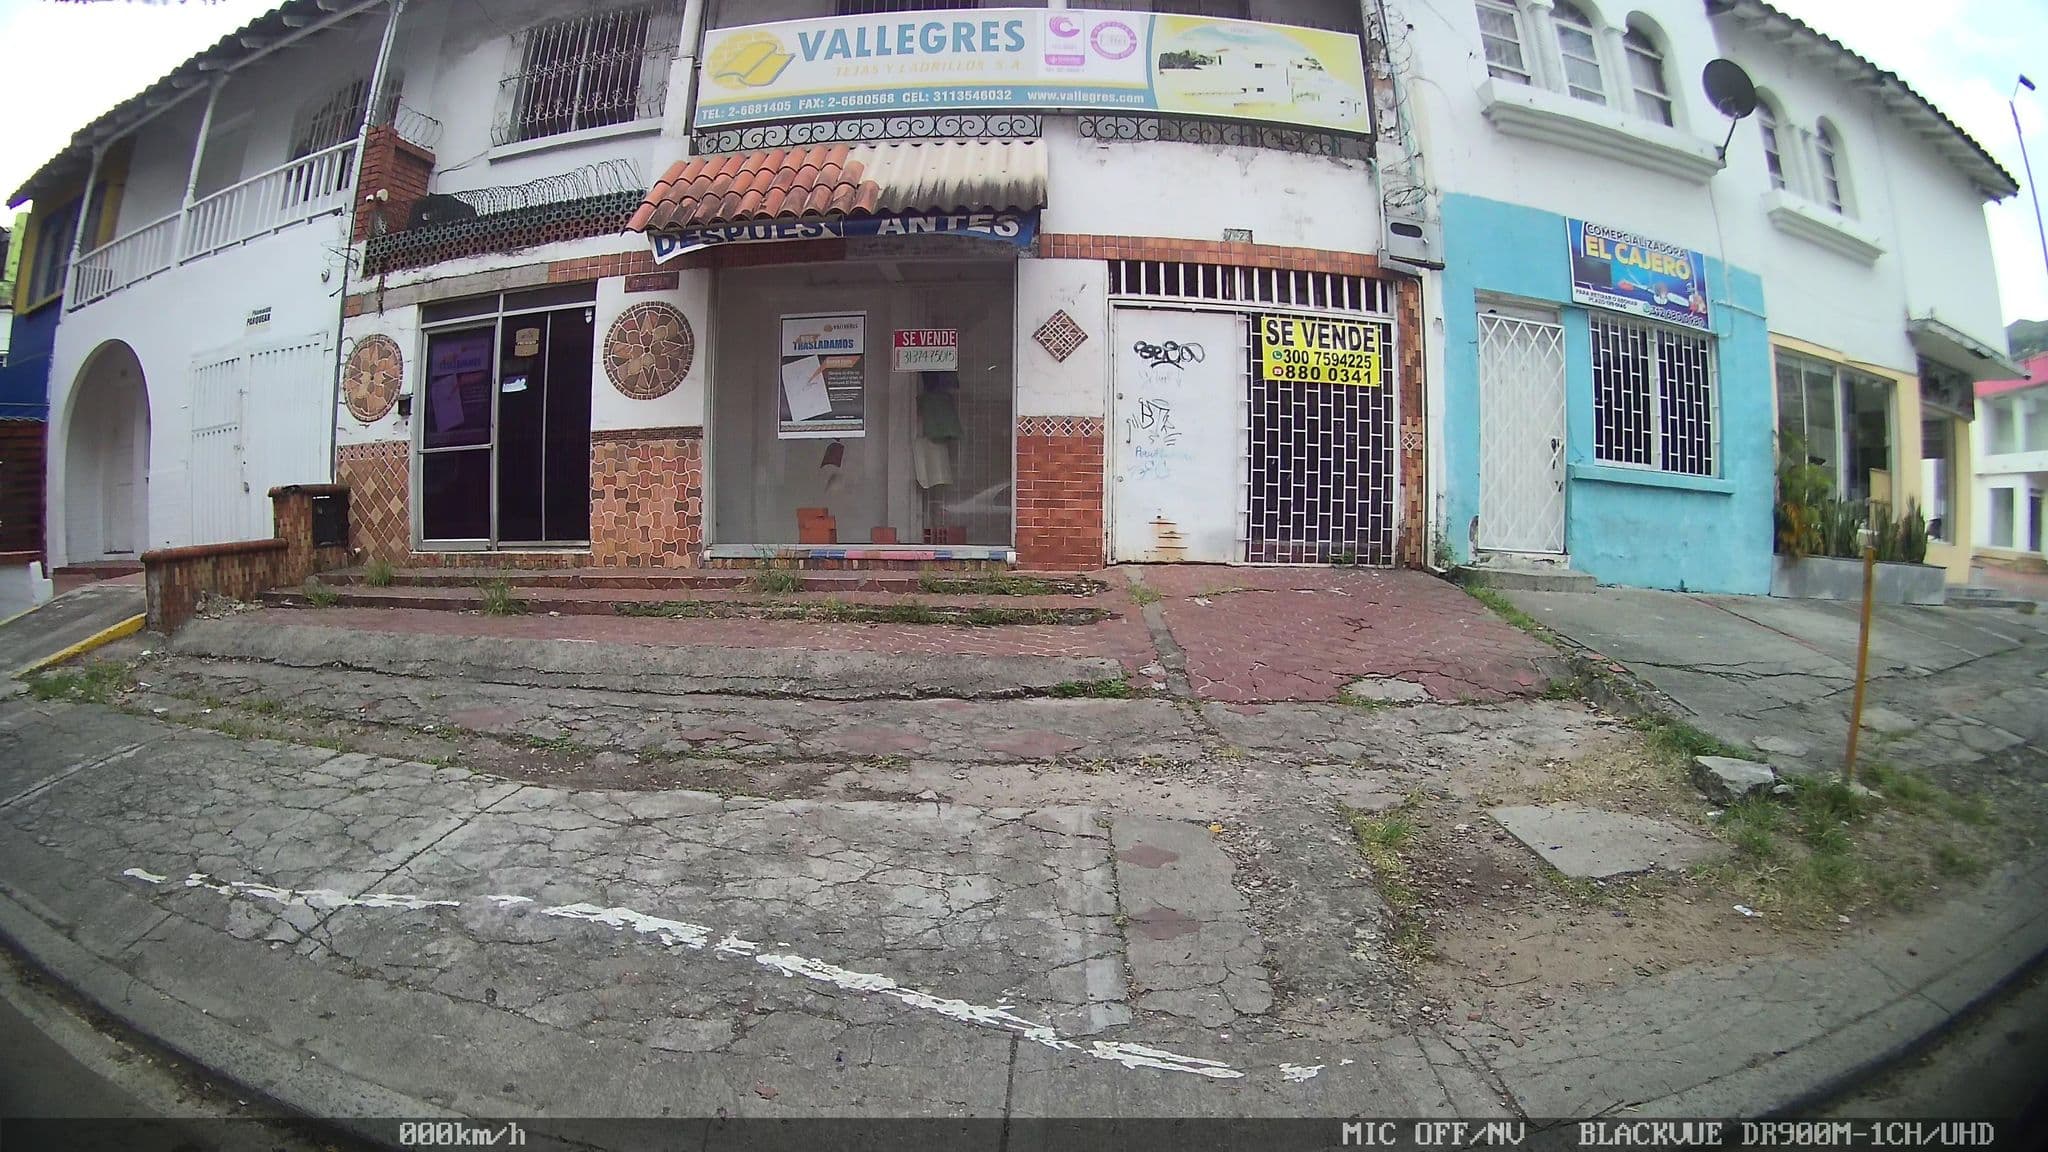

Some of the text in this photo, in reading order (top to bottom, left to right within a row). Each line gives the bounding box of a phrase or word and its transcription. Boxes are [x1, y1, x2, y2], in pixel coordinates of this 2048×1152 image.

[798, 20, 1026, 62] VALLEGRES
[702, 109, 725, 120] TEL:
[799, 98, 824, 110] FAX:
[902, 92, 929, 103] CEL:
[934, 90, 1012, 102] 3113546032
[1027, 90, 1145, 104] www.vallegres.com
[877, 214, 1020, 236] ANTES
[1585, 235, 1692, 279] EL CAJERO
[902, 330, 956, 346] SE VENDE
[1266, 319, 1376, 352] SE VENDE
[1283, 350, 1372, 369] 300 7594225
[1285, 366, 1372, 384] 880 0341
